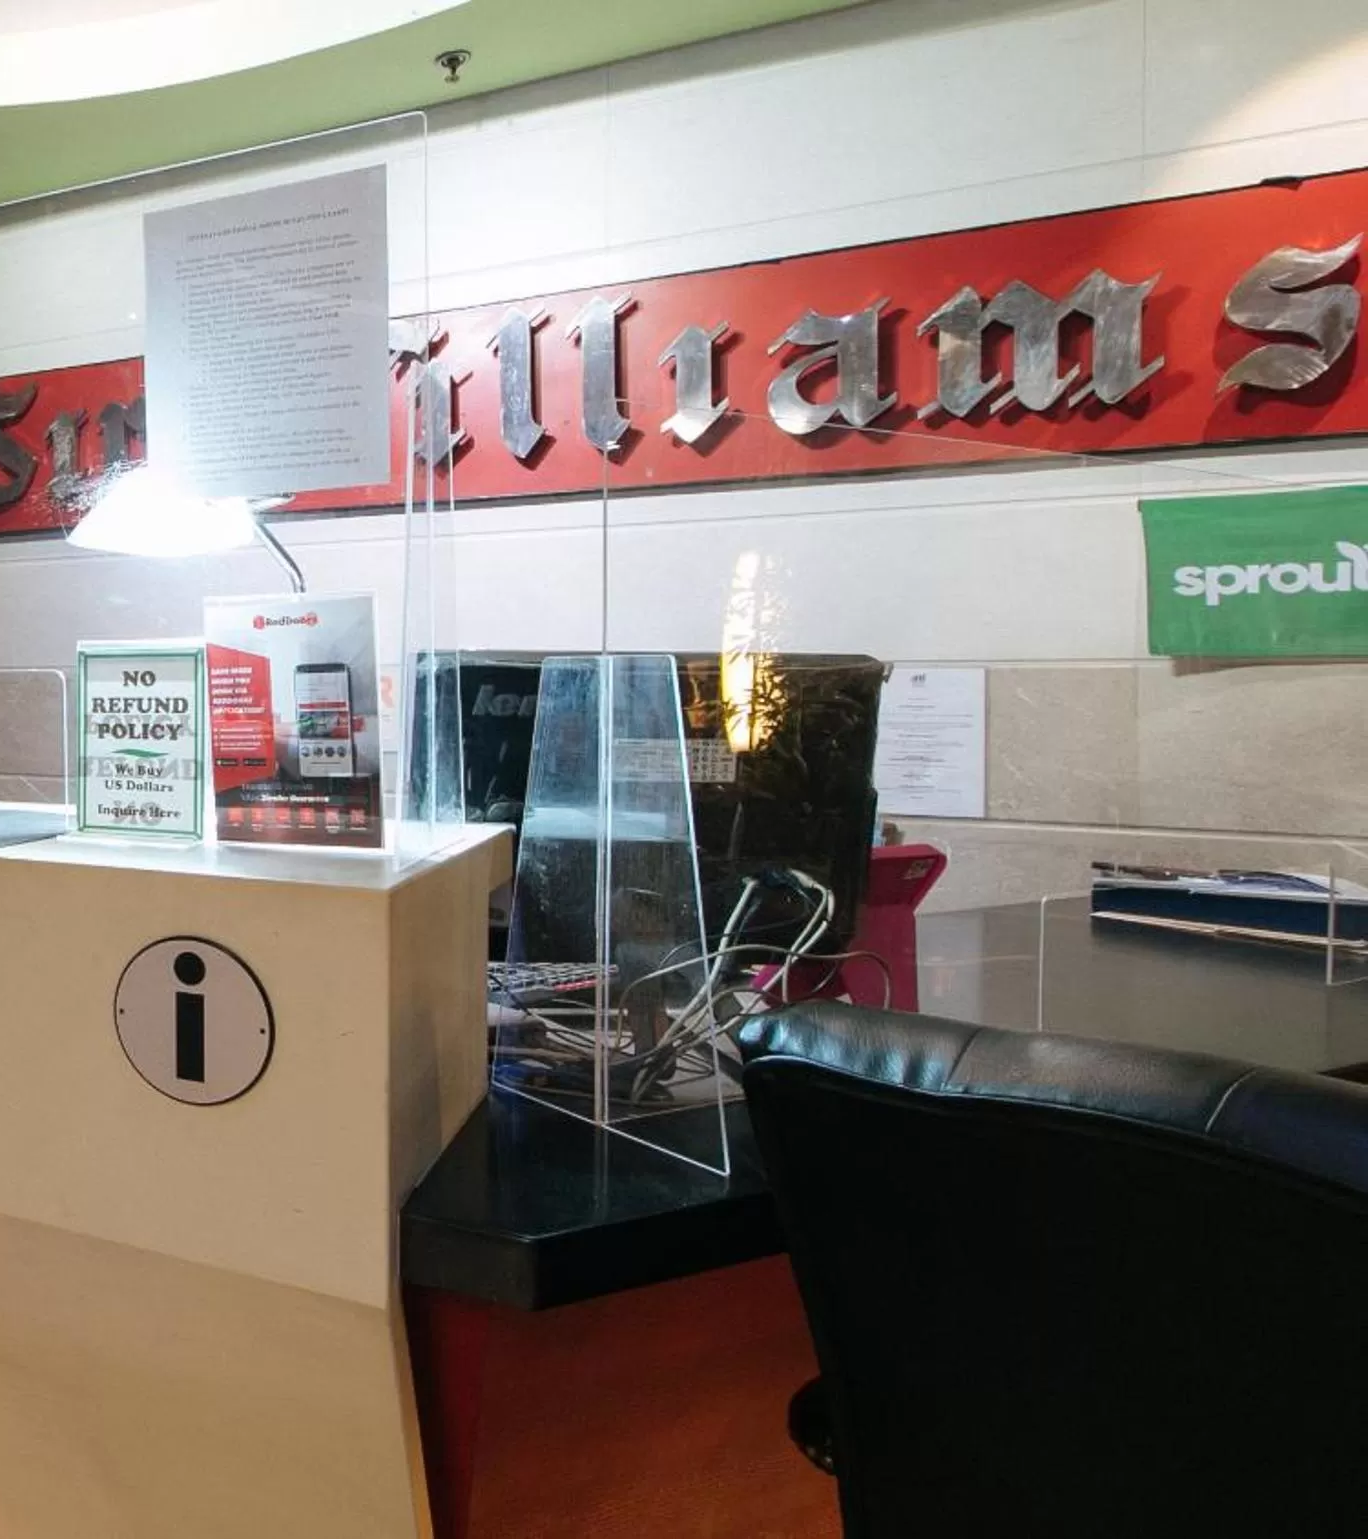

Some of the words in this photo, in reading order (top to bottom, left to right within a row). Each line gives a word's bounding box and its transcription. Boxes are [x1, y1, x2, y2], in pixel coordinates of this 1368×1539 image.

[389, 232, 1365, 467] illiams
[122, 670, 156, 687] NO
[92, 697, 189, 713] REFUND
[97, 723, 183, 741] POLICY
[115, 764, 133, 776] We
[138, 765, 163, 778] Buy
[104, 780, 122, 791] US
[126, 780, 174, 793] Dollars
[98, 803, 146, 818] Inquire
[150, 806, 181, 819] Here
